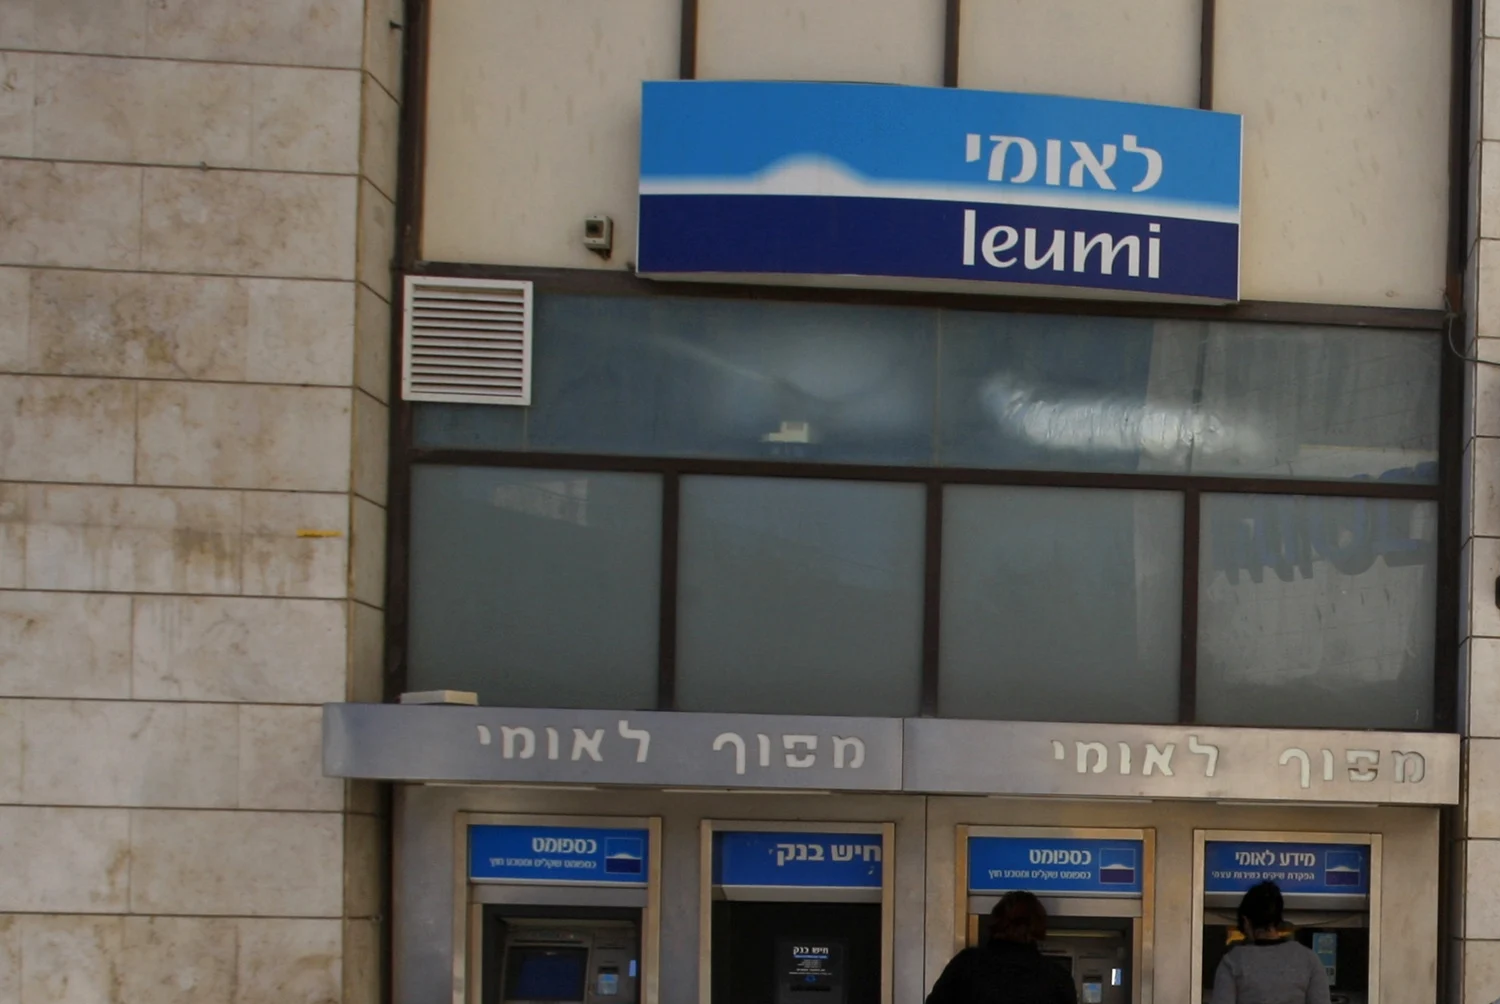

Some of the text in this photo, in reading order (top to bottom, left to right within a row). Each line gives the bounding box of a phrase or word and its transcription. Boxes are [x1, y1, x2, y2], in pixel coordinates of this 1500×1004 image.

[965, 132, 1163, 193] לאומי
[962, 208, 1161, 279] leumi
[476, 719, 651, 763] לאומי
[1050, 735, 1220, 778] לאומי
[531, 837, 597, 855] כספומט
[776, 843, 881, 867] חיש בנק
[1029, 849, 1092, 865] כספומט
[1235, 849, 1316, 867] מידע לאומי
